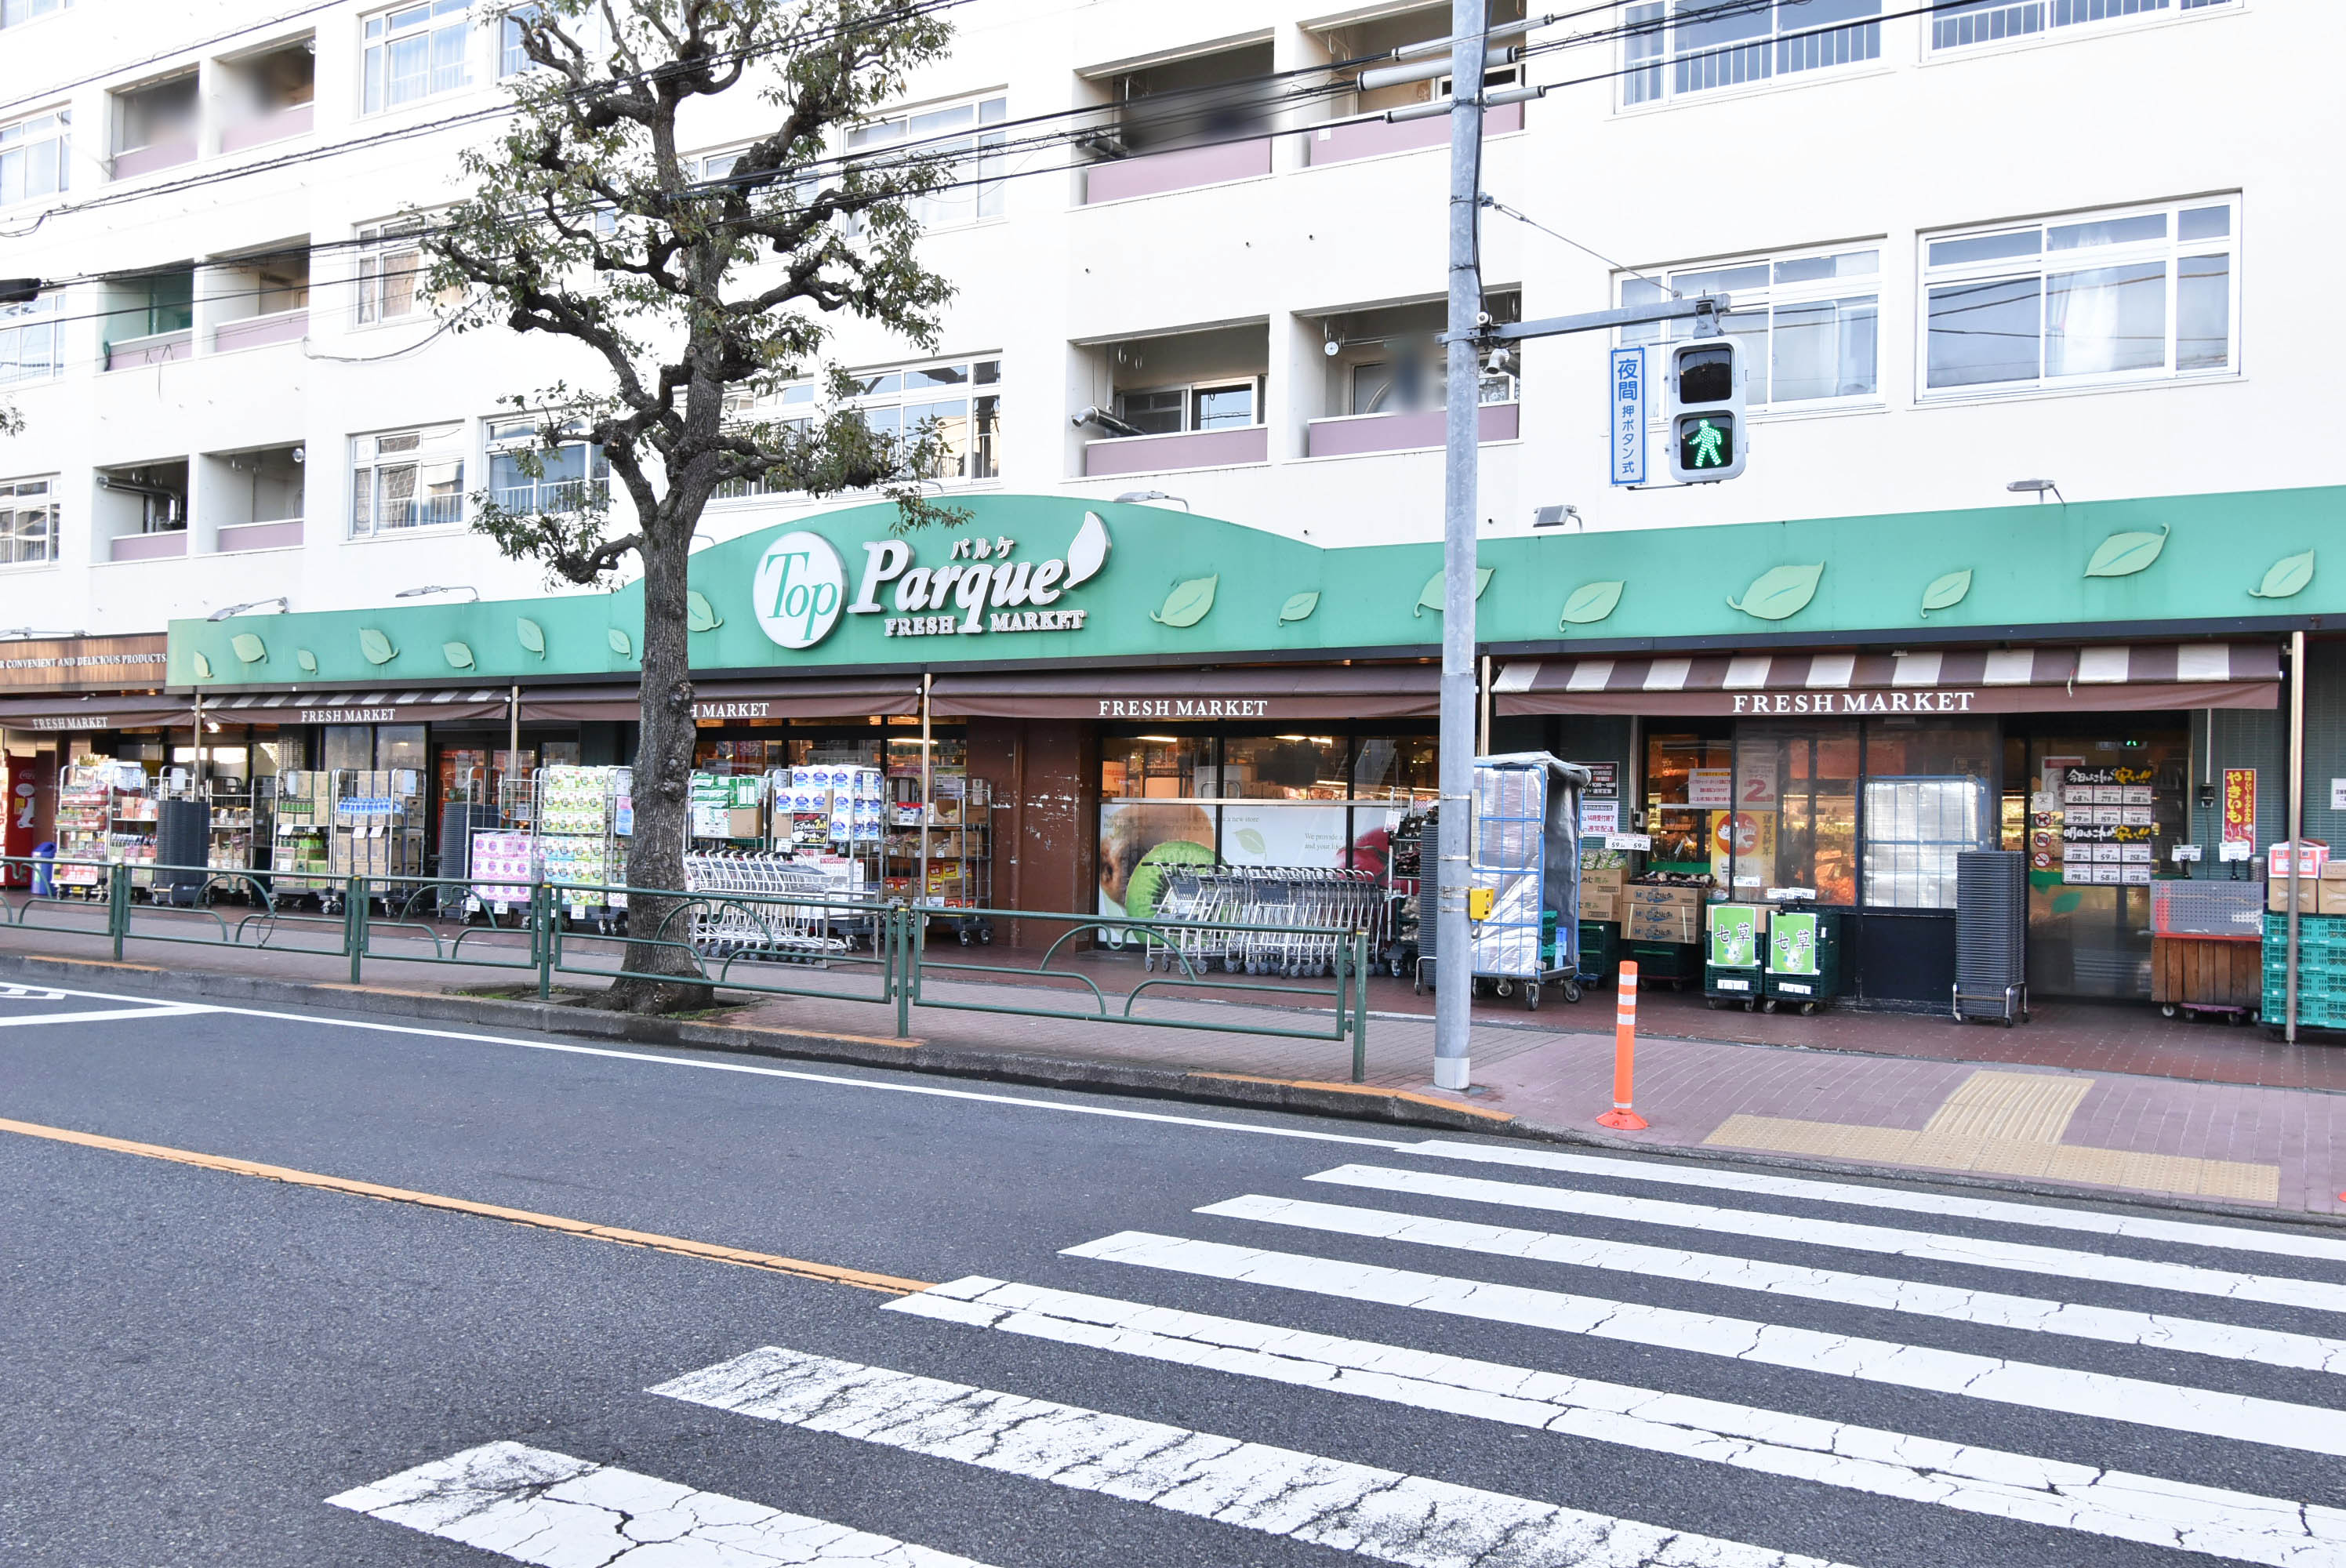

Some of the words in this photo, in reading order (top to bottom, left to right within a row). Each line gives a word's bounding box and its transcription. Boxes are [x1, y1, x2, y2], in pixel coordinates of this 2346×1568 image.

[1617, 358, 1639, 402] 夜間
[1622, 404, 1636, 474] 押ボタン式
[950, 535, 1015, 561] パルケ
[764, 550, 838, 642] Top
[846, 539, 1066, 635] Parque
[884, 615, 955, 637] FRESH
[990, 608, 1088, 633] MARKET
[6, 658, 56, 669] CONVENIENT
[58, 656, 74, 666] AND
[78, 655, 120, 666] DELICIOUS
[122, 653, 166, 665] PRODUCTS
[702, 702, 770, 718] MARKET
[1098, 699, 1171, 717] FRESH
[1175, 699, 1269, 717] MARKET
[1732, 694, 1835, 713] FRESH
[1843, 691, 1975, 713] MARKET
[32, 718, 65, 729] FRESH
[67, 717, 108, 729] MARKET
[301, 709, 342, 723] FRESH
[343, 708, 396, 722] MARKET
[2226, 771, 2242, 823] やきいも
[1316, 833, 1338, 841] provide
[1716, 923, 1751, 946] 七草
[1774, 930, 1810, 953] 七草
